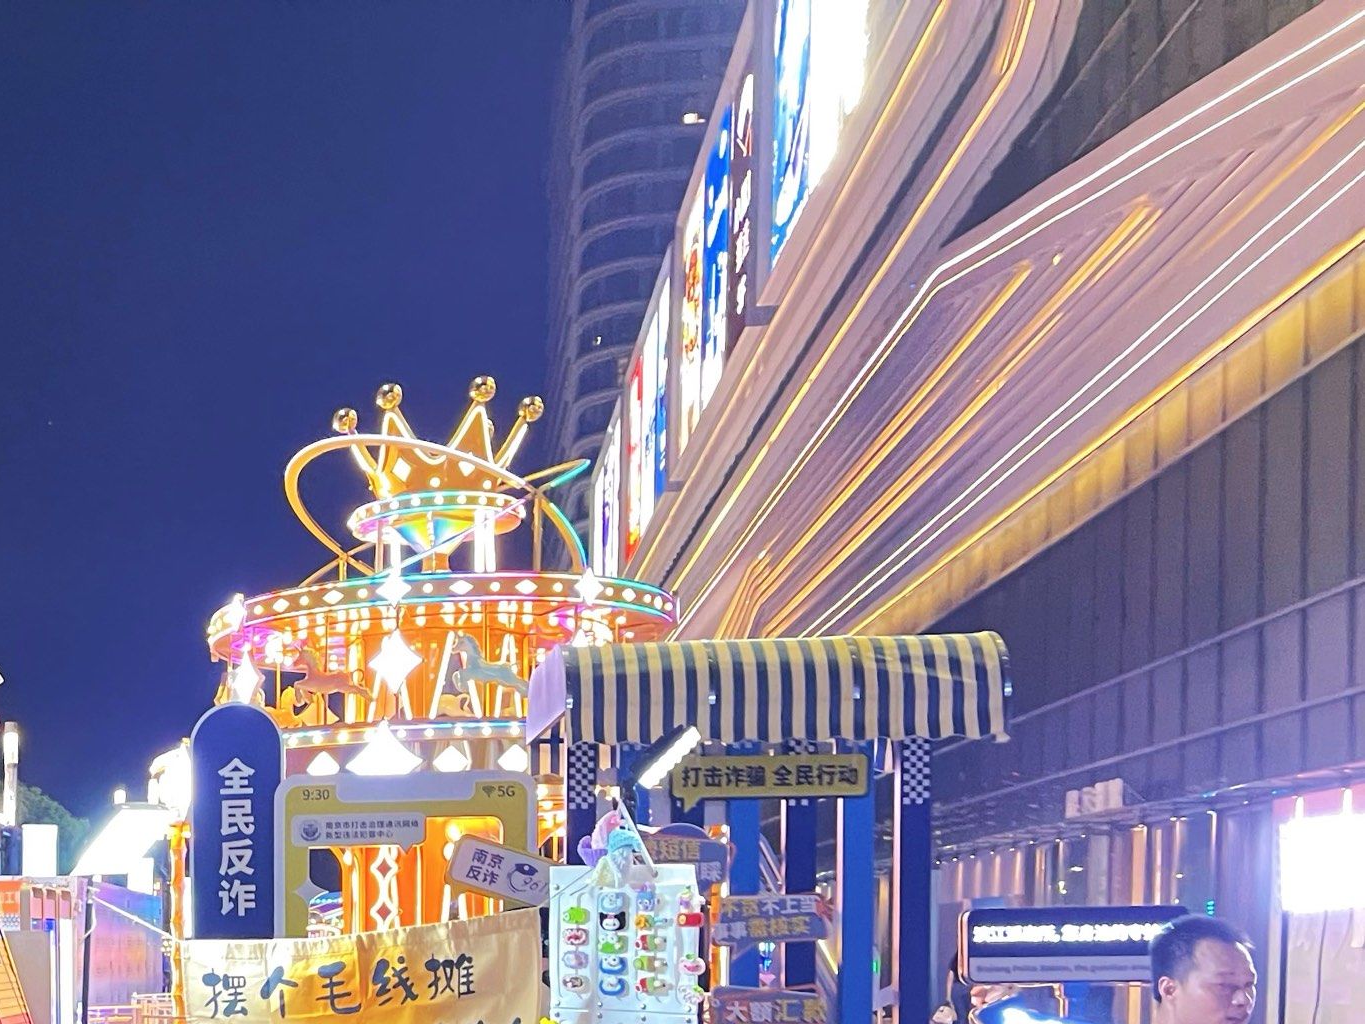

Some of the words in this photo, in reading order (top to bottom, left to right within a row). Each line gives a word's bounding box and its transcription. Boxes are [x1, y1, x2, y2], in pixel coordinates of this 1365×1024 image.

[682, 765, 766, 787] 打击诈骗
[773, 764, 858, 787] 全民行动
[302, 788, 330, 801] 9:30
[497, 785, 516, 798] 5G
[218, 758, 256, 916] 全民反诈
[471, 848, 505, 869] 南京
[466, 865, 499, 886] 反诈
[202, 953, 476, 1018] 摆个毛线摊
